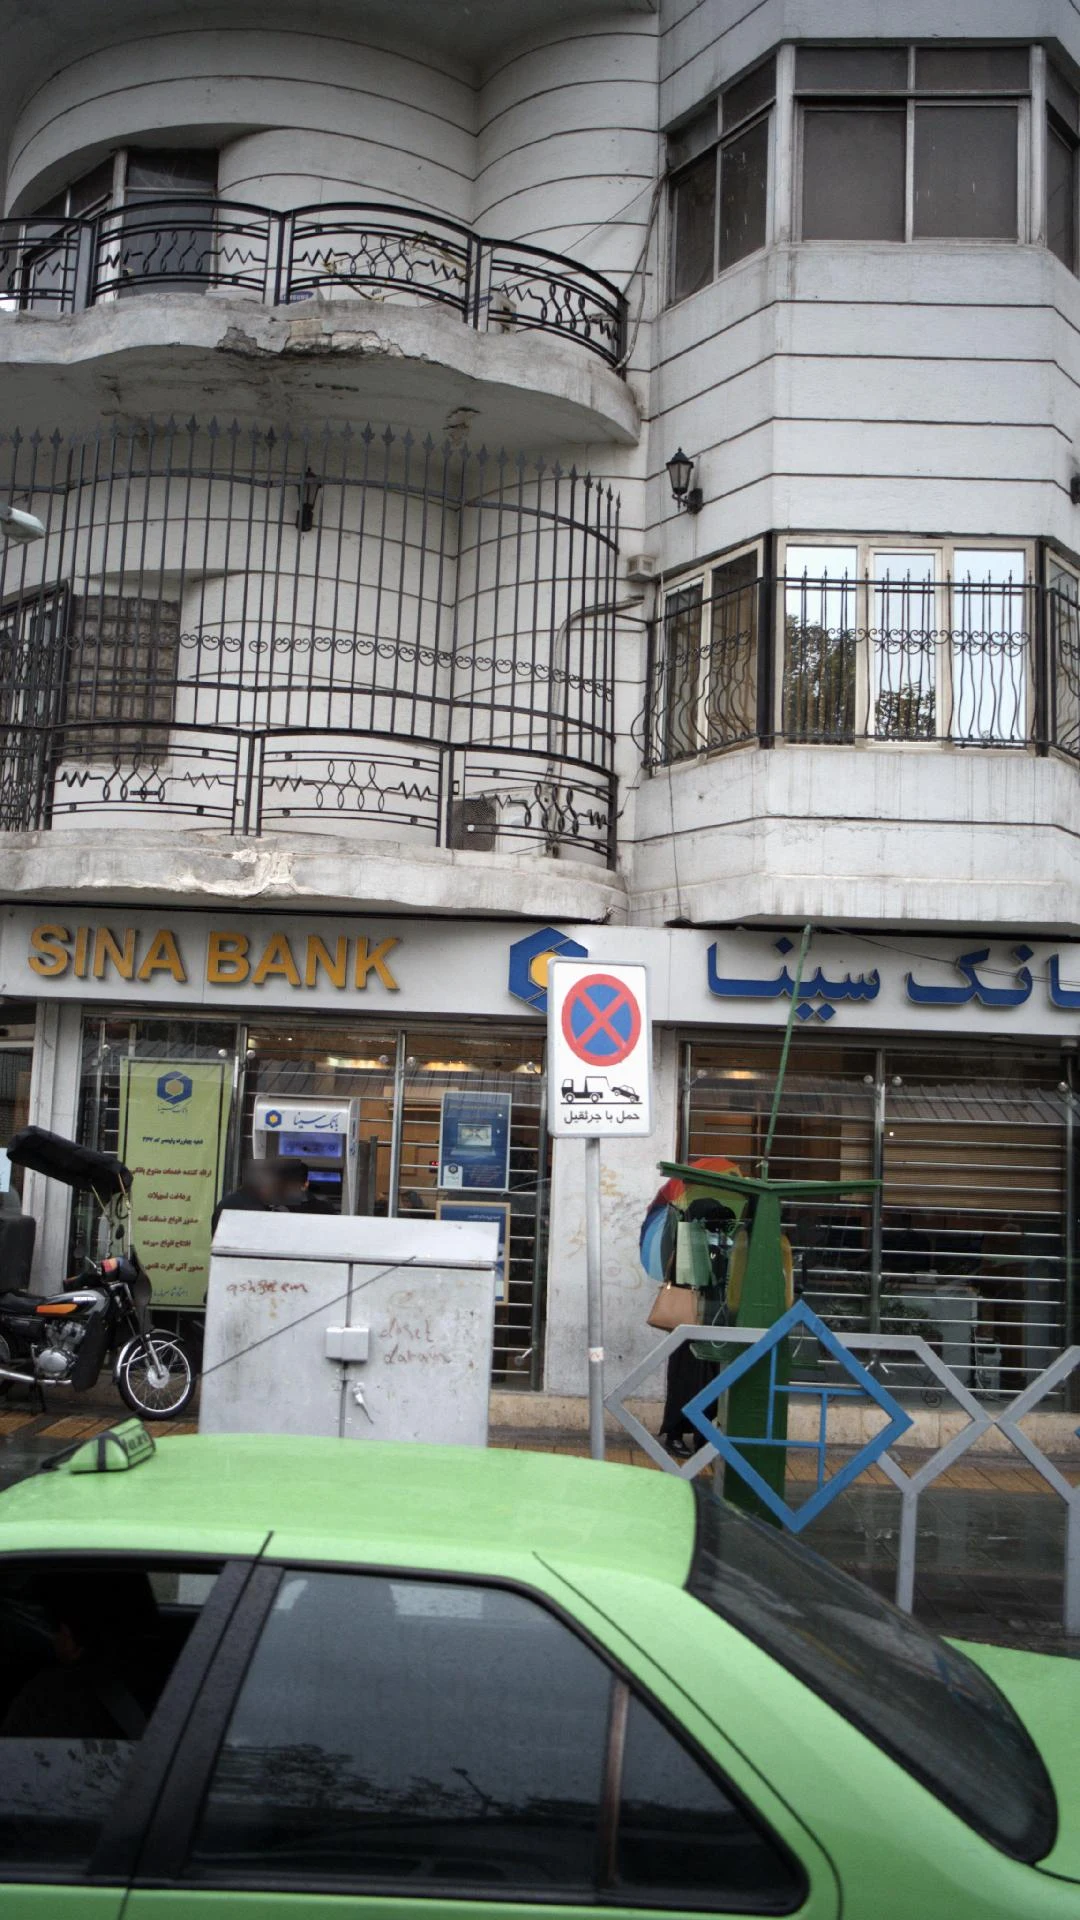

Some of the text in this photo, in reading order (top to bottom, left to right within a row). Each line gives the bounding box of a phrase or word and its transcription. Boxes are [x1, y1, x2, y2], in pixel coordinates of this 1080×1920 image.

[28, 923, 402, 991] SINA BANK
[706, 936, 1080, 1023] انک سینا
[293, 1111, 341, 1131] بانک سینا
[563, 1110, 640, 1124] حمل با جرثقیل
